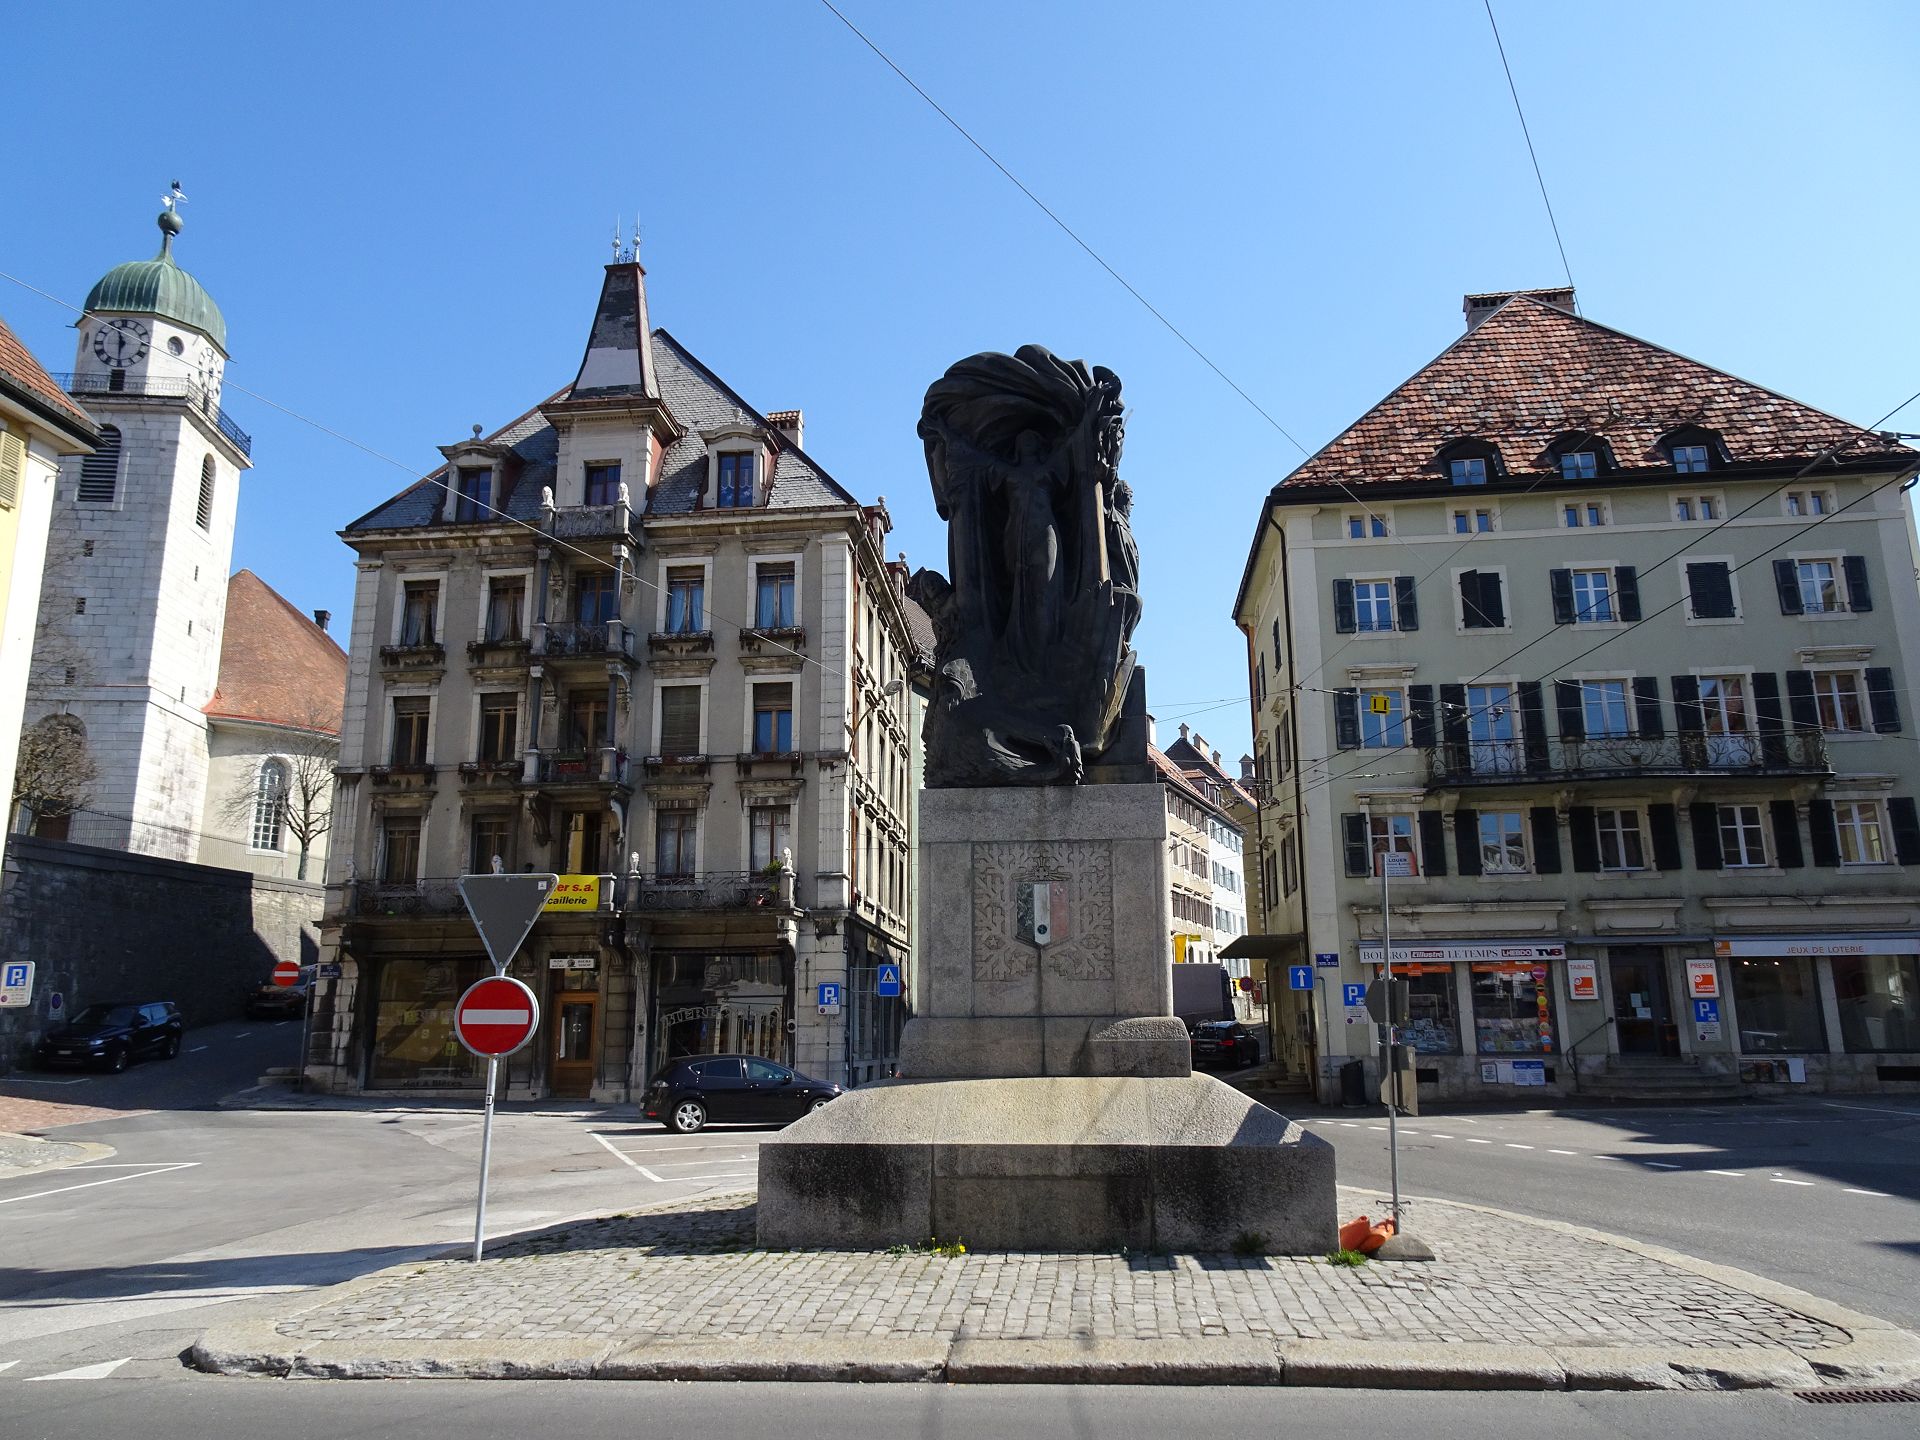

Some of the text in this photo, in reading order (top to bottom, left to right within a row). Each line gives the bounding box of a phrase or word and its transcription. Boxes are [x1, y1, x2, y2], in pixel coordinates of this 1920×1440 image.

[554, 884, 594, 892] er s.a.
[547, 896, 588, 905] caillerie
[1363, 951, 1408, 960] BOLRO
[1447, 950, 1462, 959] LE
[1462, 949, 1498, 958] TEMPS
[1536, 948, 1563, 956] TV8
[1787, 945, 1865, 954] JEUX DE LOTERIE
[11, 968, 23, 985] P
[824, 987, 835, 1003] P
[1347, 986, 1359, 1001] P
[1698, 1001, 1710, 1017] P
